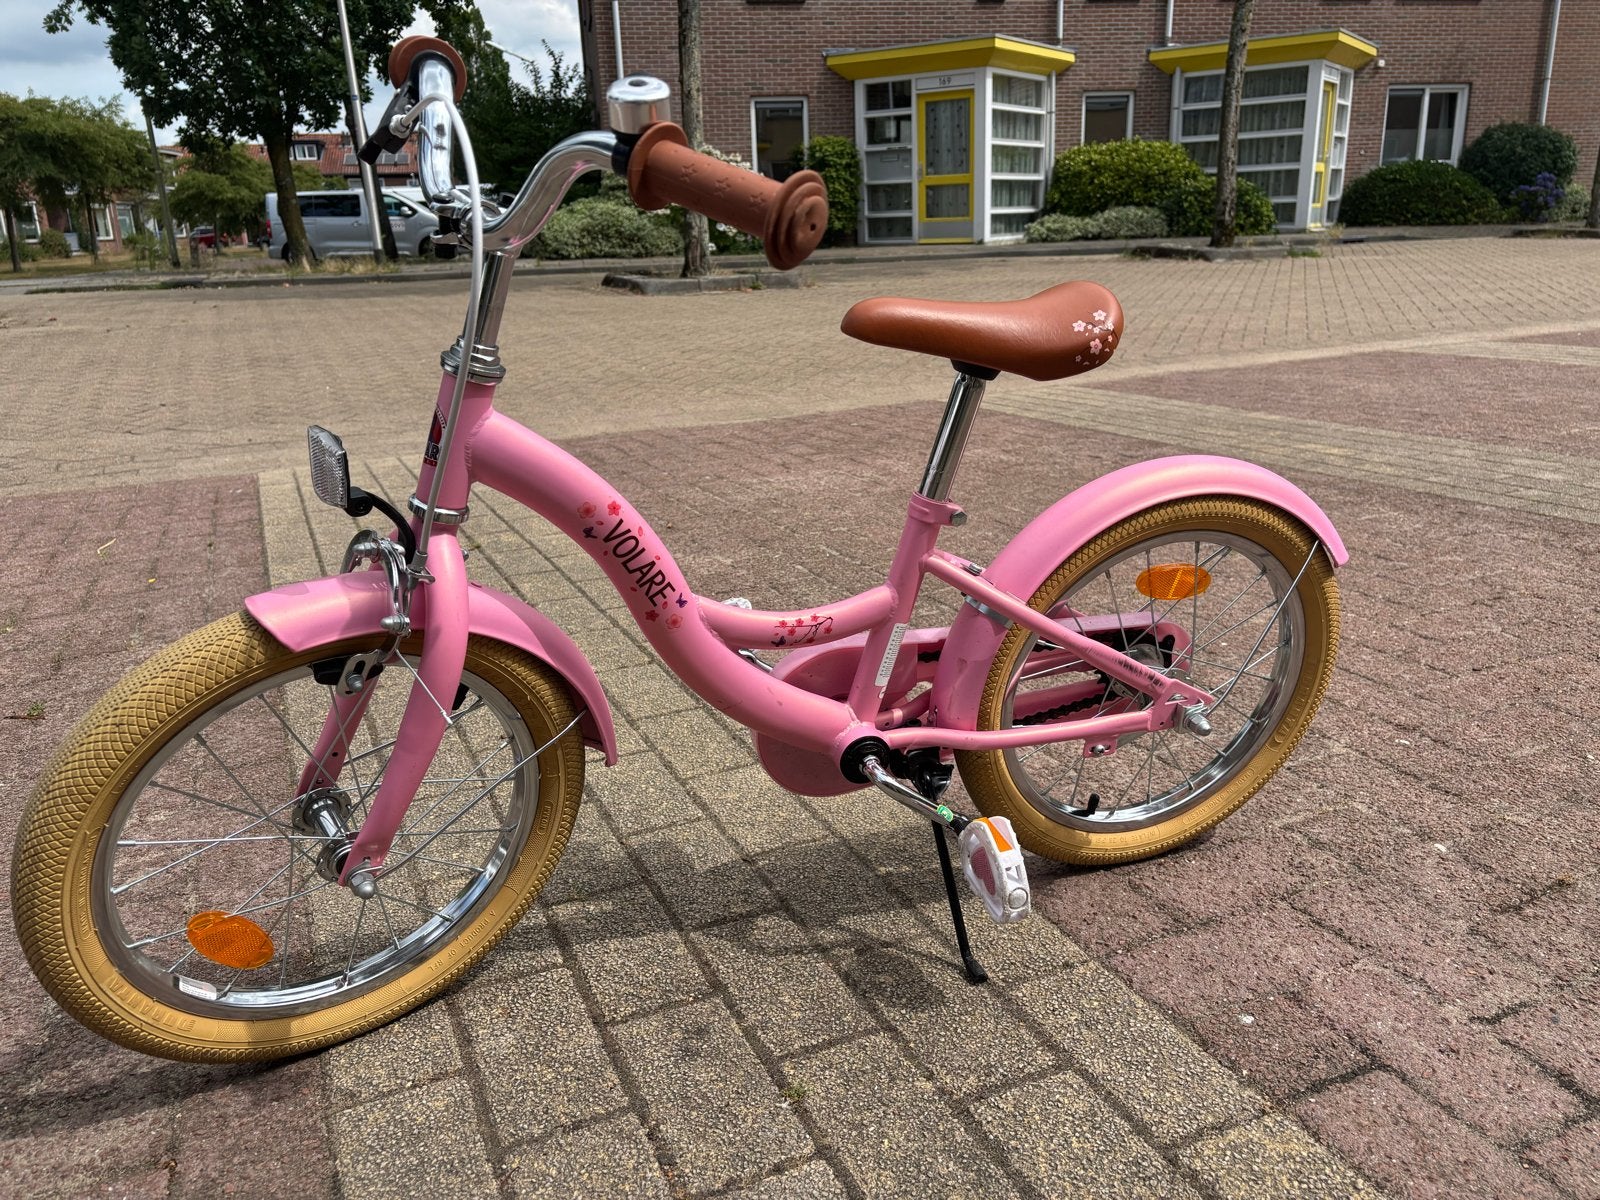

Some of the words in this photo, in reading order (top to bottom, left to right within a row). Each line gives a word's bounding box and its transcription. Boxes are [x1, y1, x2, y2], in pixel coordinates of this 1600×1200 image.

[603, 518, 677, 608] VOLARE
[459, 918, 489, 949] PRODUCT
[446, 949, 457, 960] OF
